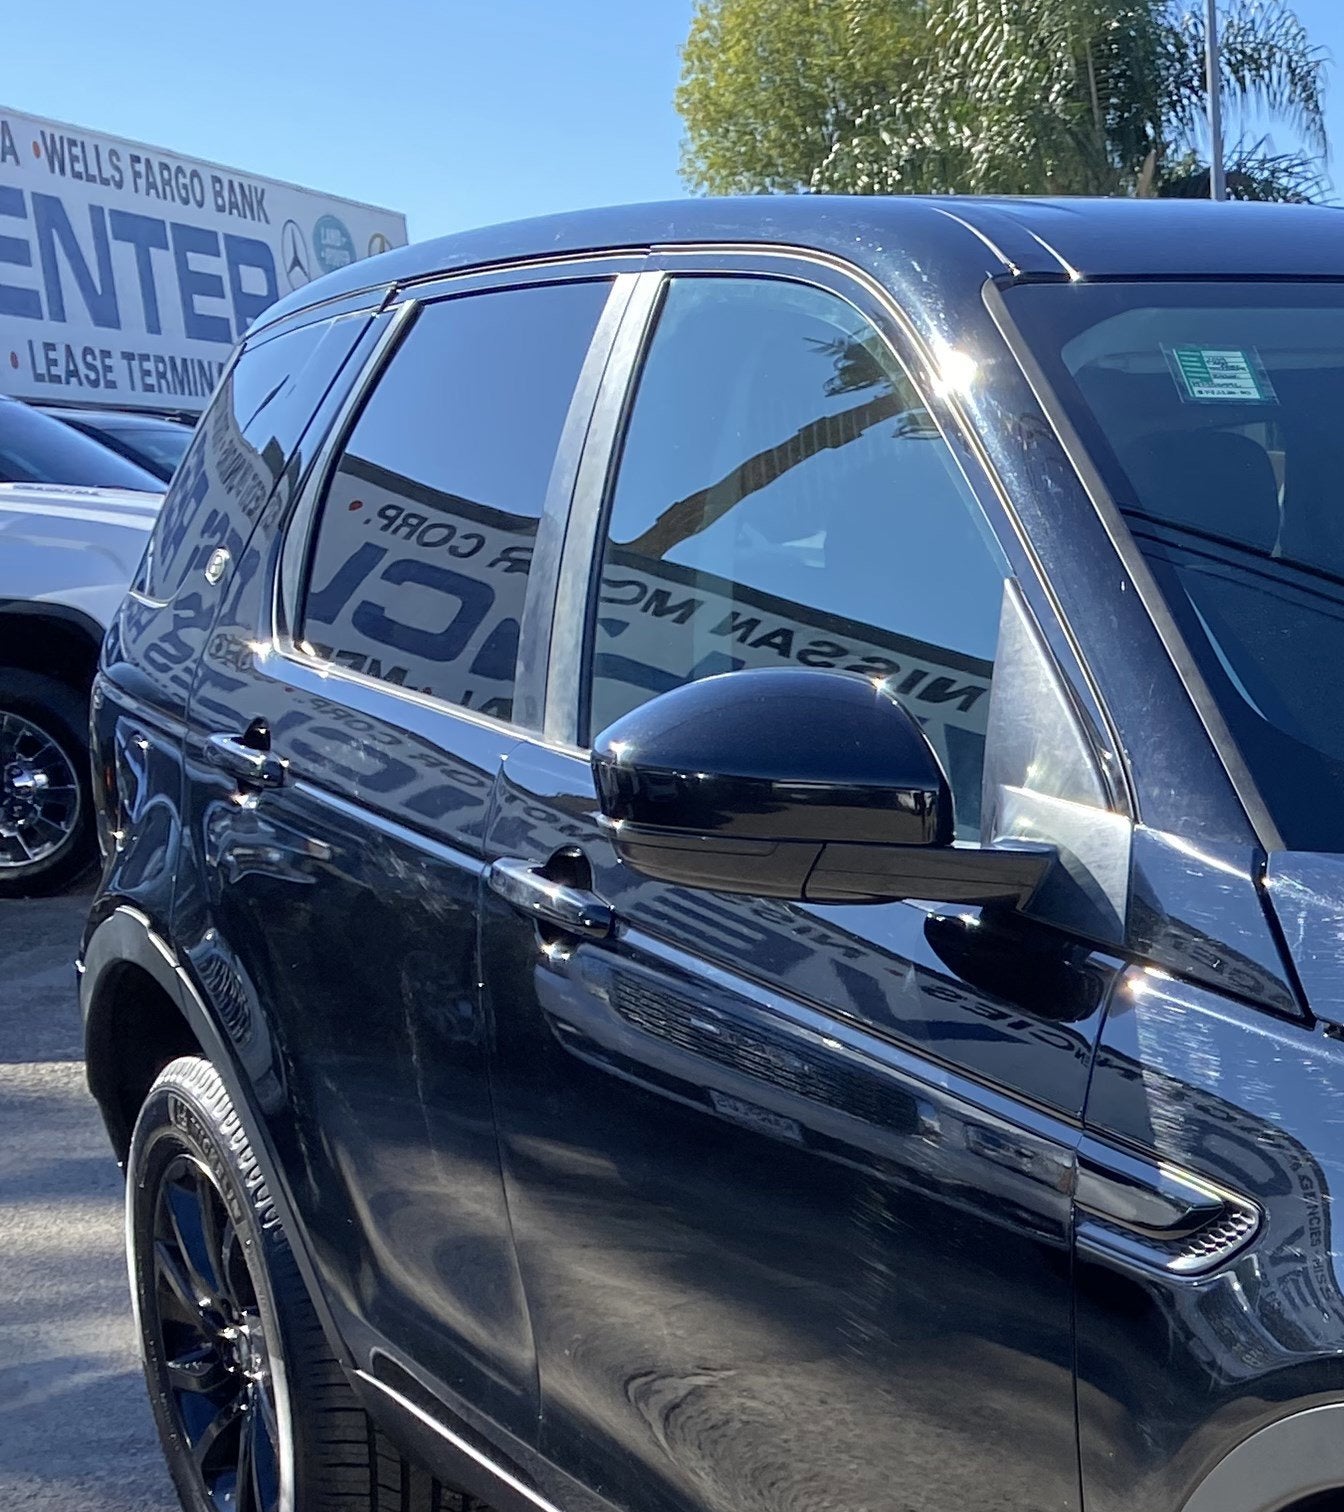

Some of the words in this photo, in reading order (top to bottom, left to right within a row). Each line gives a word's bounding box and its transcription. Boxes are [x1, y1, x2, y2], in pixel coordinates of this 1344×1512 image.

[39, 129, 124, 190] WELLS
[128, 153, 205, 209] FARGO
[211, 174, 271, 225] BANK
[27, 339, 117, 391] LEASE
